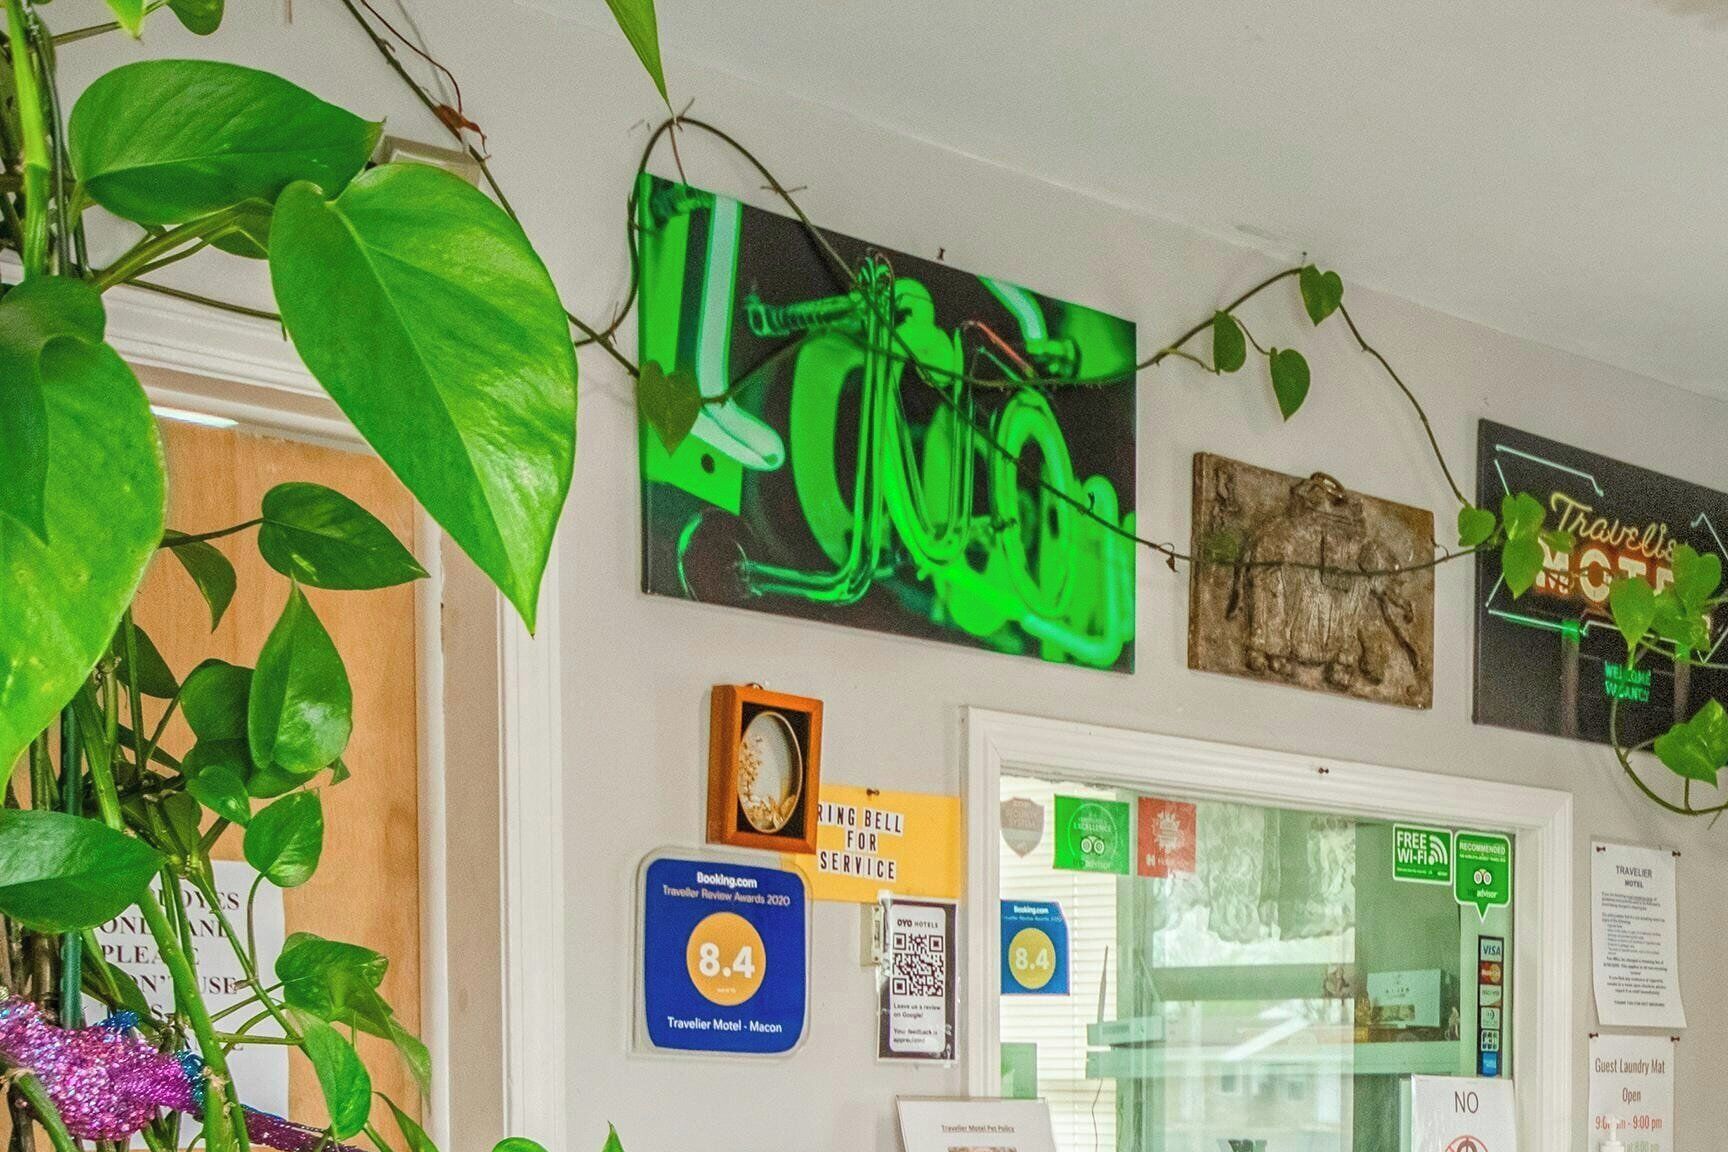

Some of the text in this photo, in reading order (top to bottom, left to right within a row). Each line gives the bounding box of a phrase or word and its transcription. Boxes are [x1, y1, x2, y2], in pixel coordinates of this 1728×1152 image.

[864, 809, 901, 833] BELL
[847, 830, 876, 851] FOR
[1396, 831, 1427, 850] FREE
[1459, 841, 1506, 855] RECOMMENDED
[820, 850, 895, 879] SERVICE
[1397, 848, 1427, 865] WI-FI
[696, 871, 758, 888] Booking.com
[701, 888, 732, 901] Review
[734, 892, 765, 905] Awards
[767, 894, 791, 906] 2020
[897, 919, 938, 929] OYO HOTELS
[1015, 947, 1050, 970] 8.4
[1482, 945, 1501, 956] VISA
[699, 942, 756, 979] 8.4
[713, 1018, 742, 1031] Motel
[749, 1020, 783, 1033] Macon
[1595, 1057, 1665, 1076] Guest Laundry Mat
[1454, 1091, 1479, 1114] NO
[1622, 1086, 1641, 1104] Open
[1632, 1114, 1650, 1130] 9:00
[1651, 1118, 1663, 1132] pm
